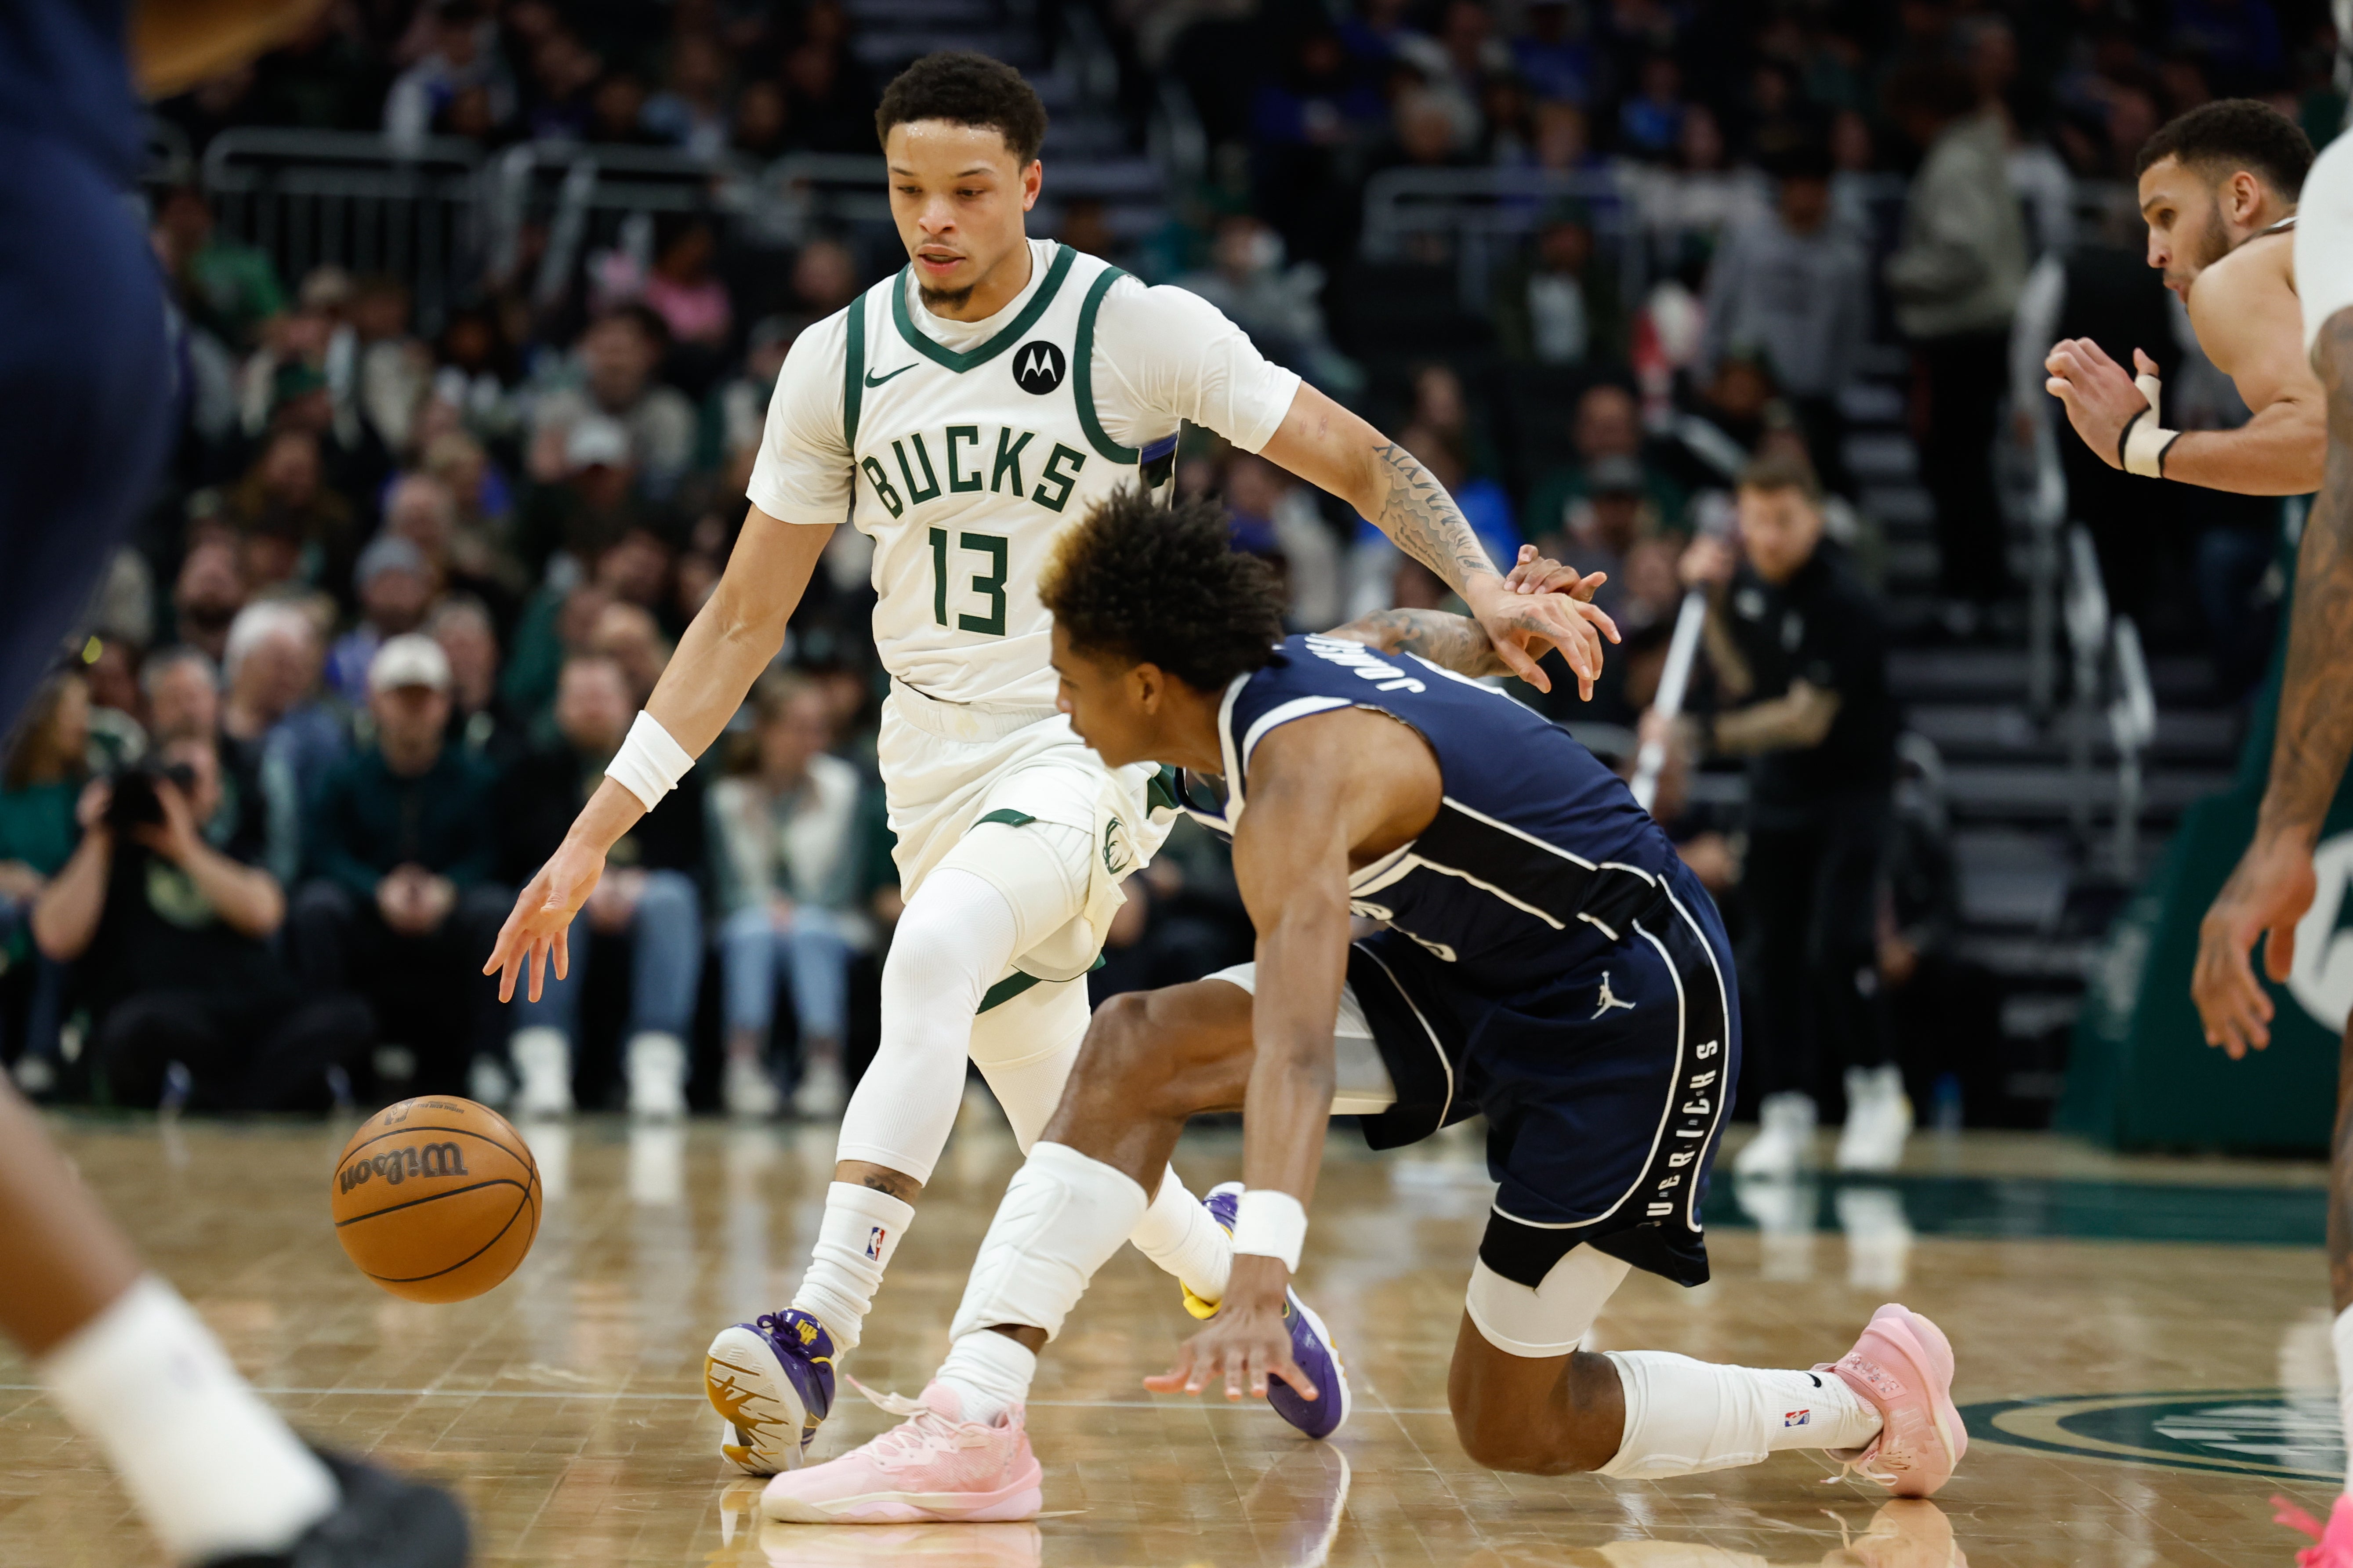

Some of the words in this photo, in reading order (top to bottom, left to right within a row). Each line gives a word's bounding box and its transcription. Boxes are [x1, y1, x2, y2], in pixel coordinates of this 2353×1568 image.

[860, 424, 1088, 521] BUCKS
[928, 526, 1008, 637] 13
[340, 1141, 468, 1195] Wilson
